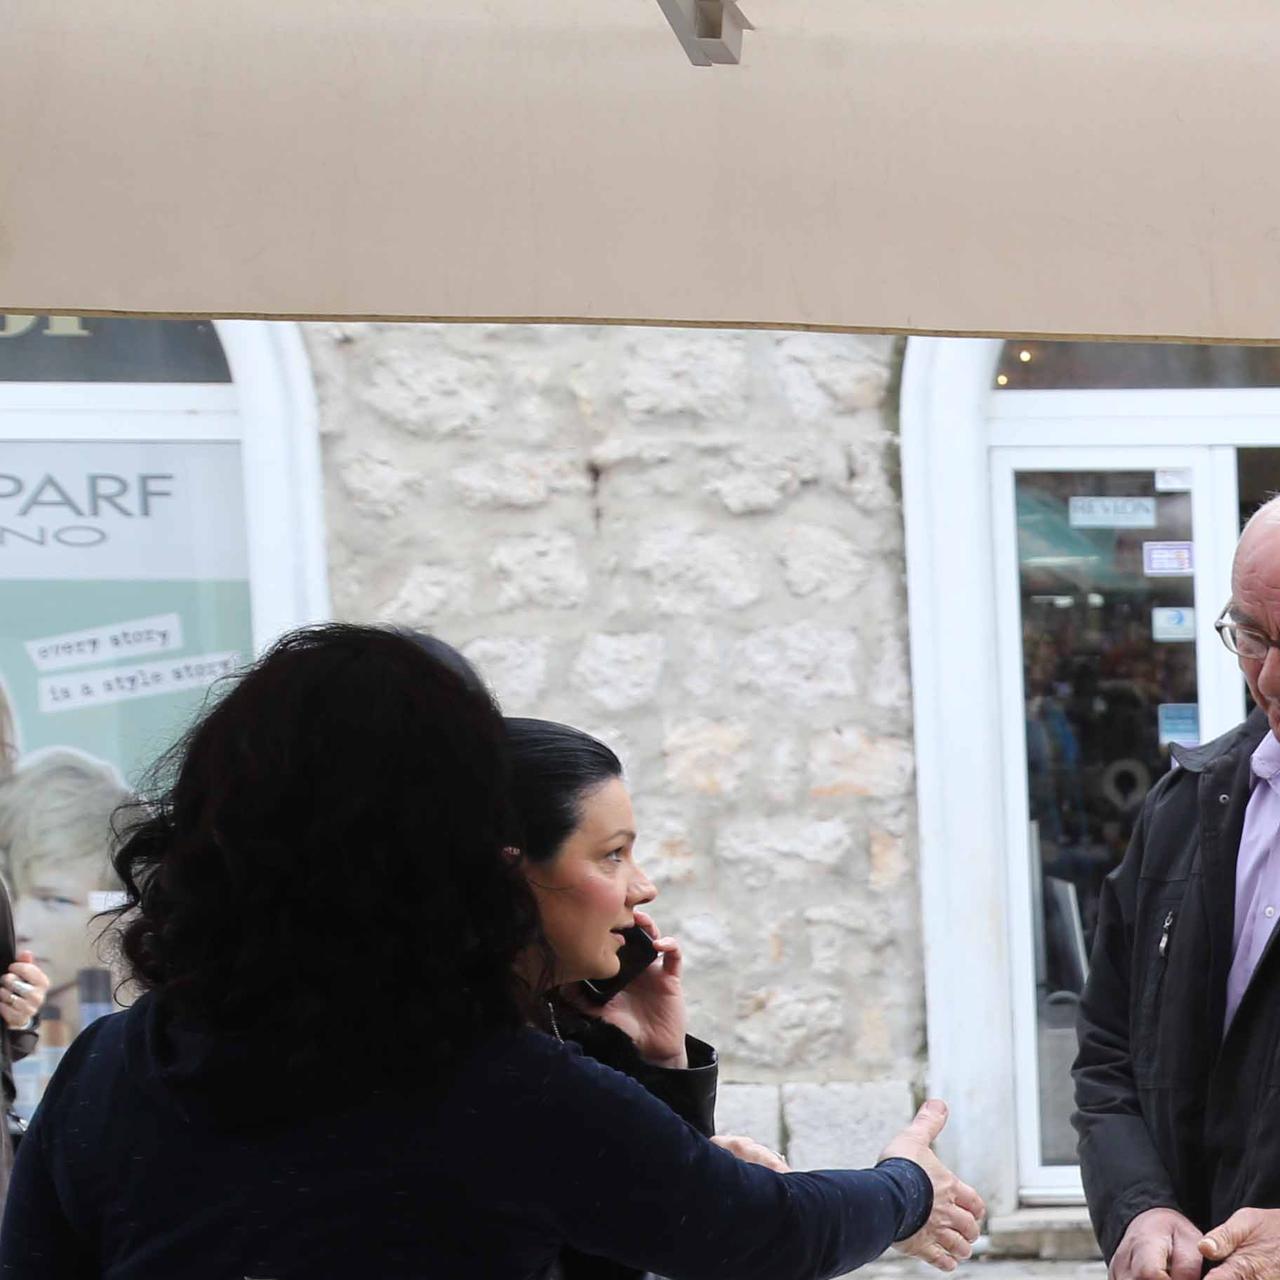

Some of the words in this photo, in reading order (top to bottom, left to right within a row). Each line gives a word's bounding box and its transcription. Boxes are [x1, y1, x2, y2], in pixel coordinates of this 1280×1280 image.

[37, 637, 101, 659] every
[108, 628, 170, 647] story
[49, 684, 71, 702] is
[80, 682, 94, 698] a
[101, 668, 164, 693] style
